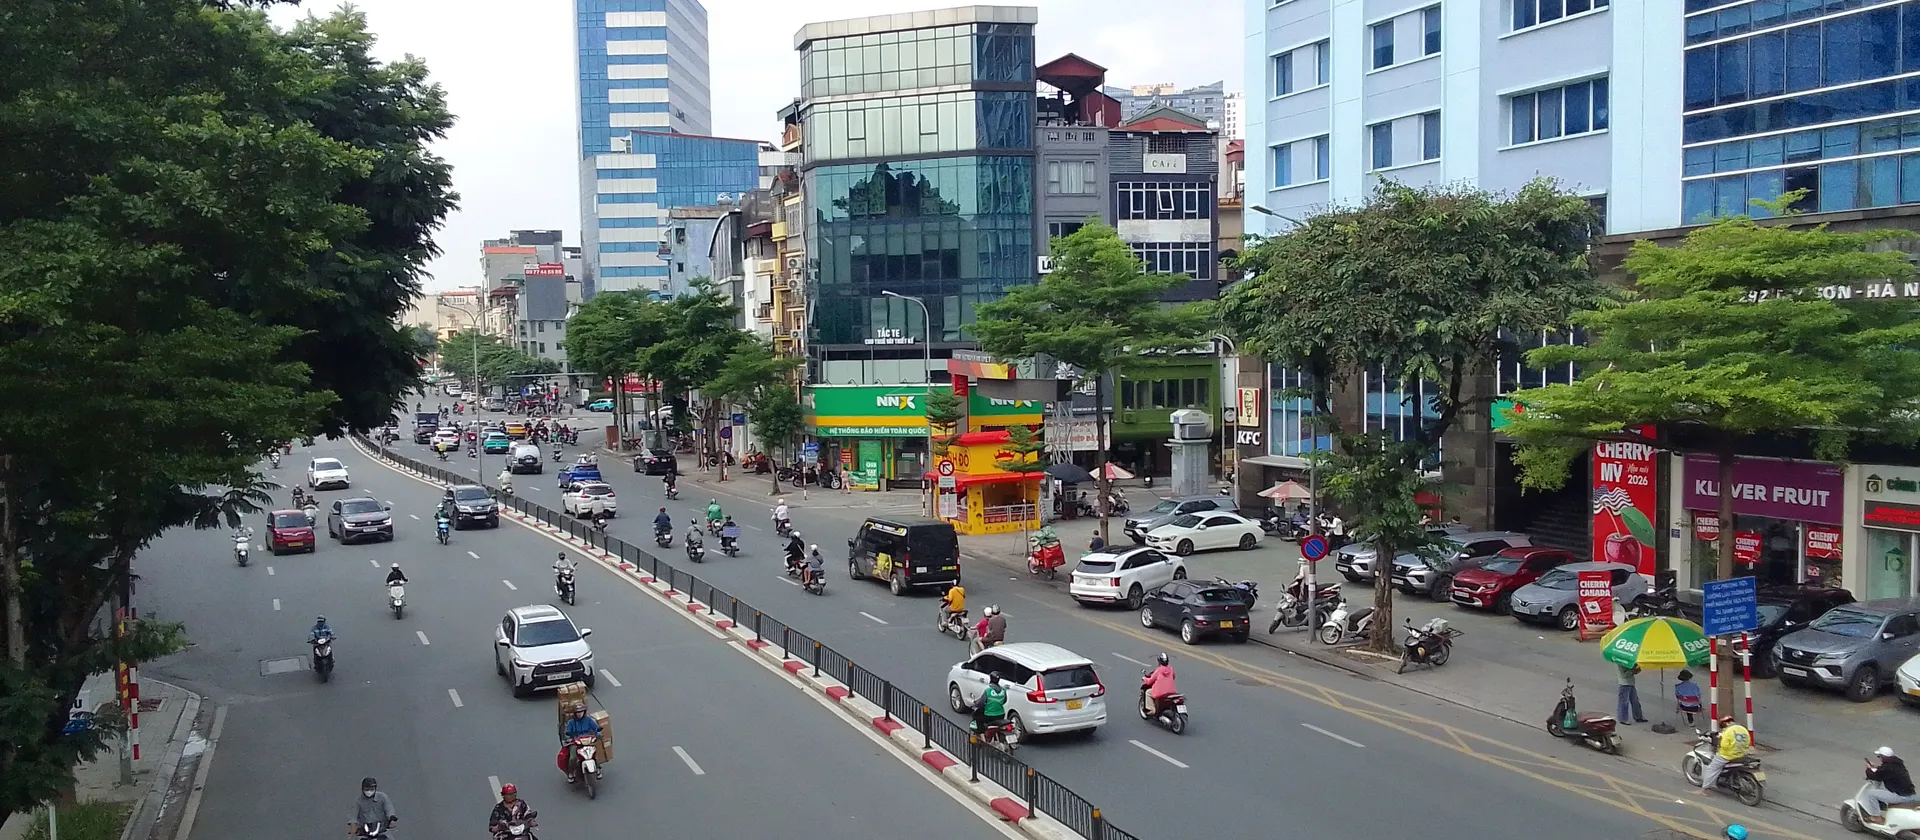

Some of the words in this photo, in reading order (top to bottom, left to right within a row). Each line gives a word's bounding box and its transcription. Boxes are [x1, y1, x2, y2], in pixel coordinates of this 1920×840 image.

[891, 329, 900, 338] TE
[874, 426, 890, 434] HIỂM
[1237, 430, 1262, 445] KFC
[1597, 440, 1652, 461] CHERRY
[1601, 461, 1623, 482] MỸ
[1628, 474, 1648, 486] 2026
[1696, 480, 1767, 501] KLVER
[1773, 486, 1830, 507] FRUIT
[1696, 517, 1719, 526] CHERR
[1808, 531, 1839, 542] CHERRY
